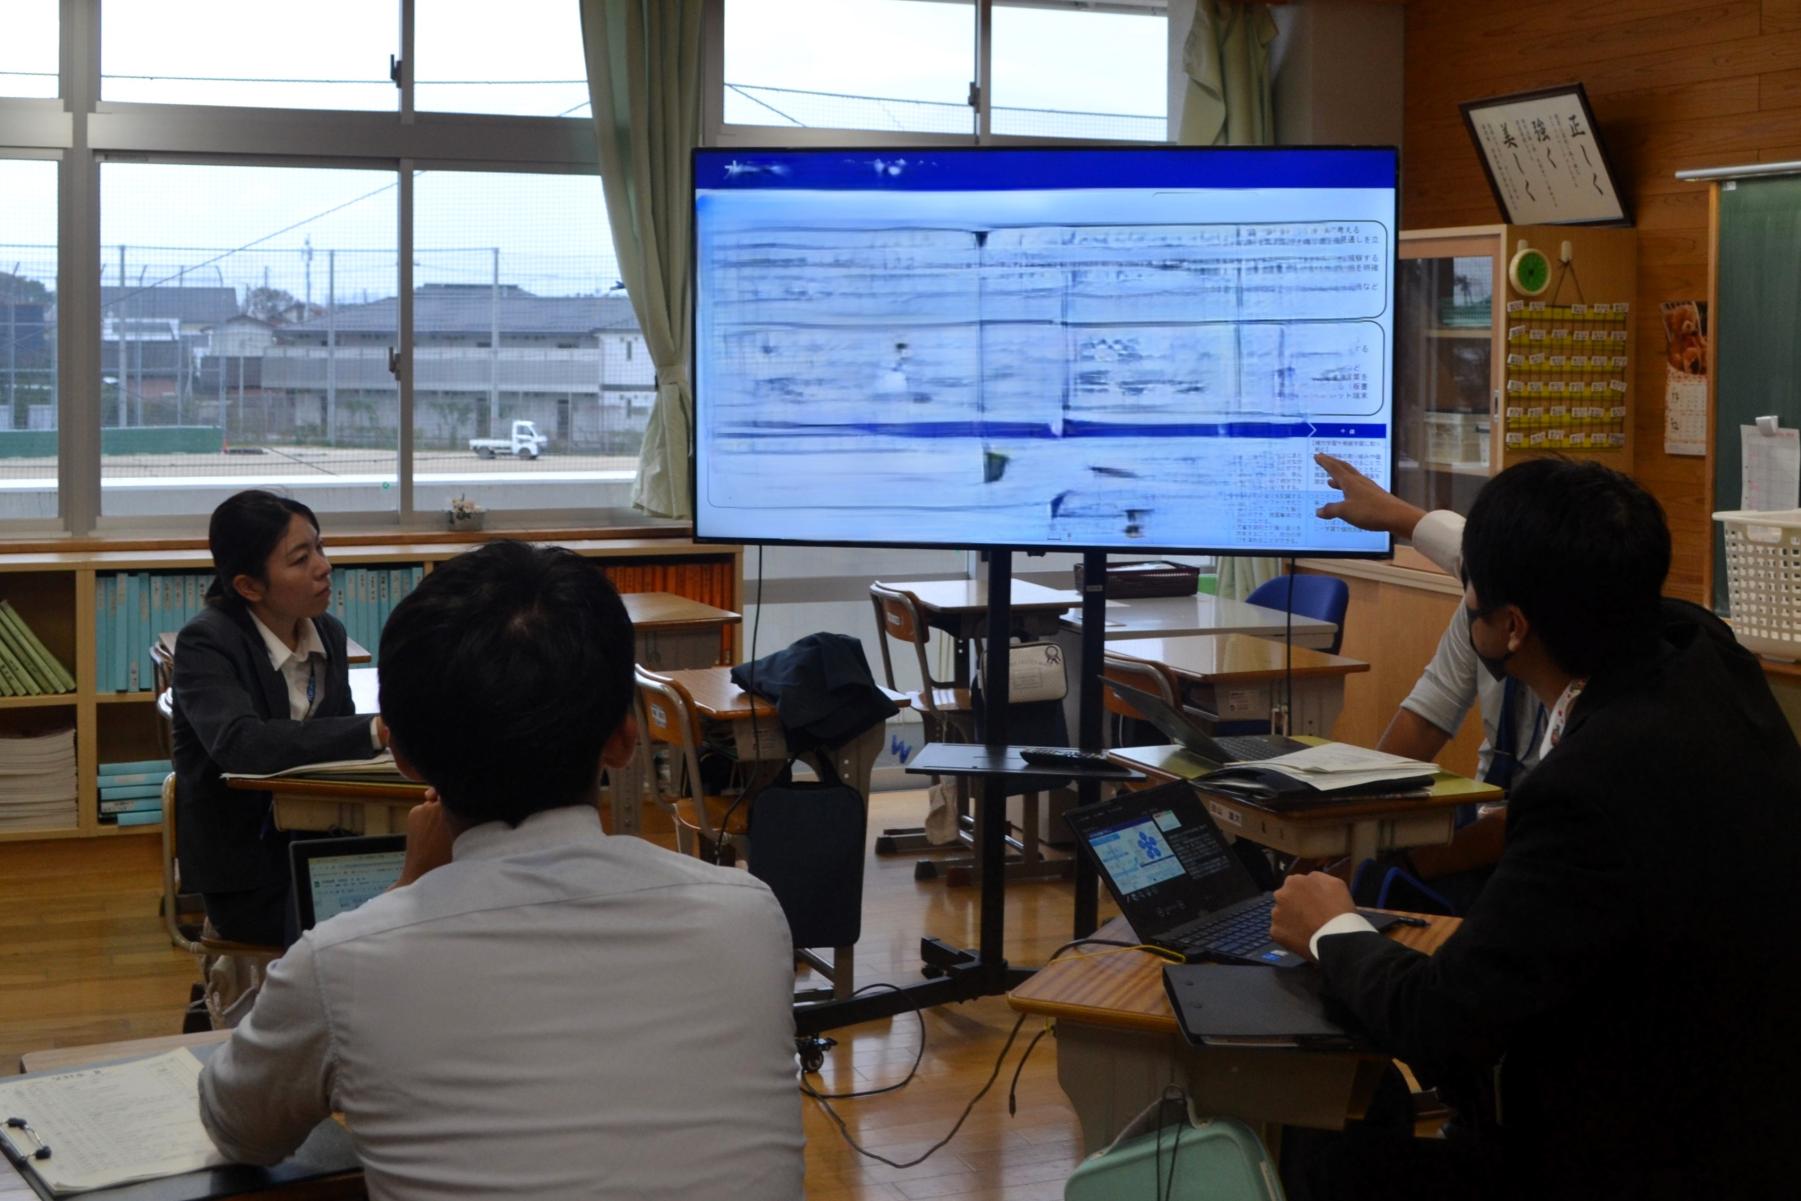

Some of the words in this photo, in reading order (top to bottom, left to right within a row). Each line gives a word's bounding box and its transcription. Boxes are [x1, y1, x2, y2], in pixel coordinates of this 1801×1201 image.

[1500, 122, 1536, 202] 美しく
[1531, 118, 1557, 169] 強く
[1567, 114, 1604, 196] 正しく
